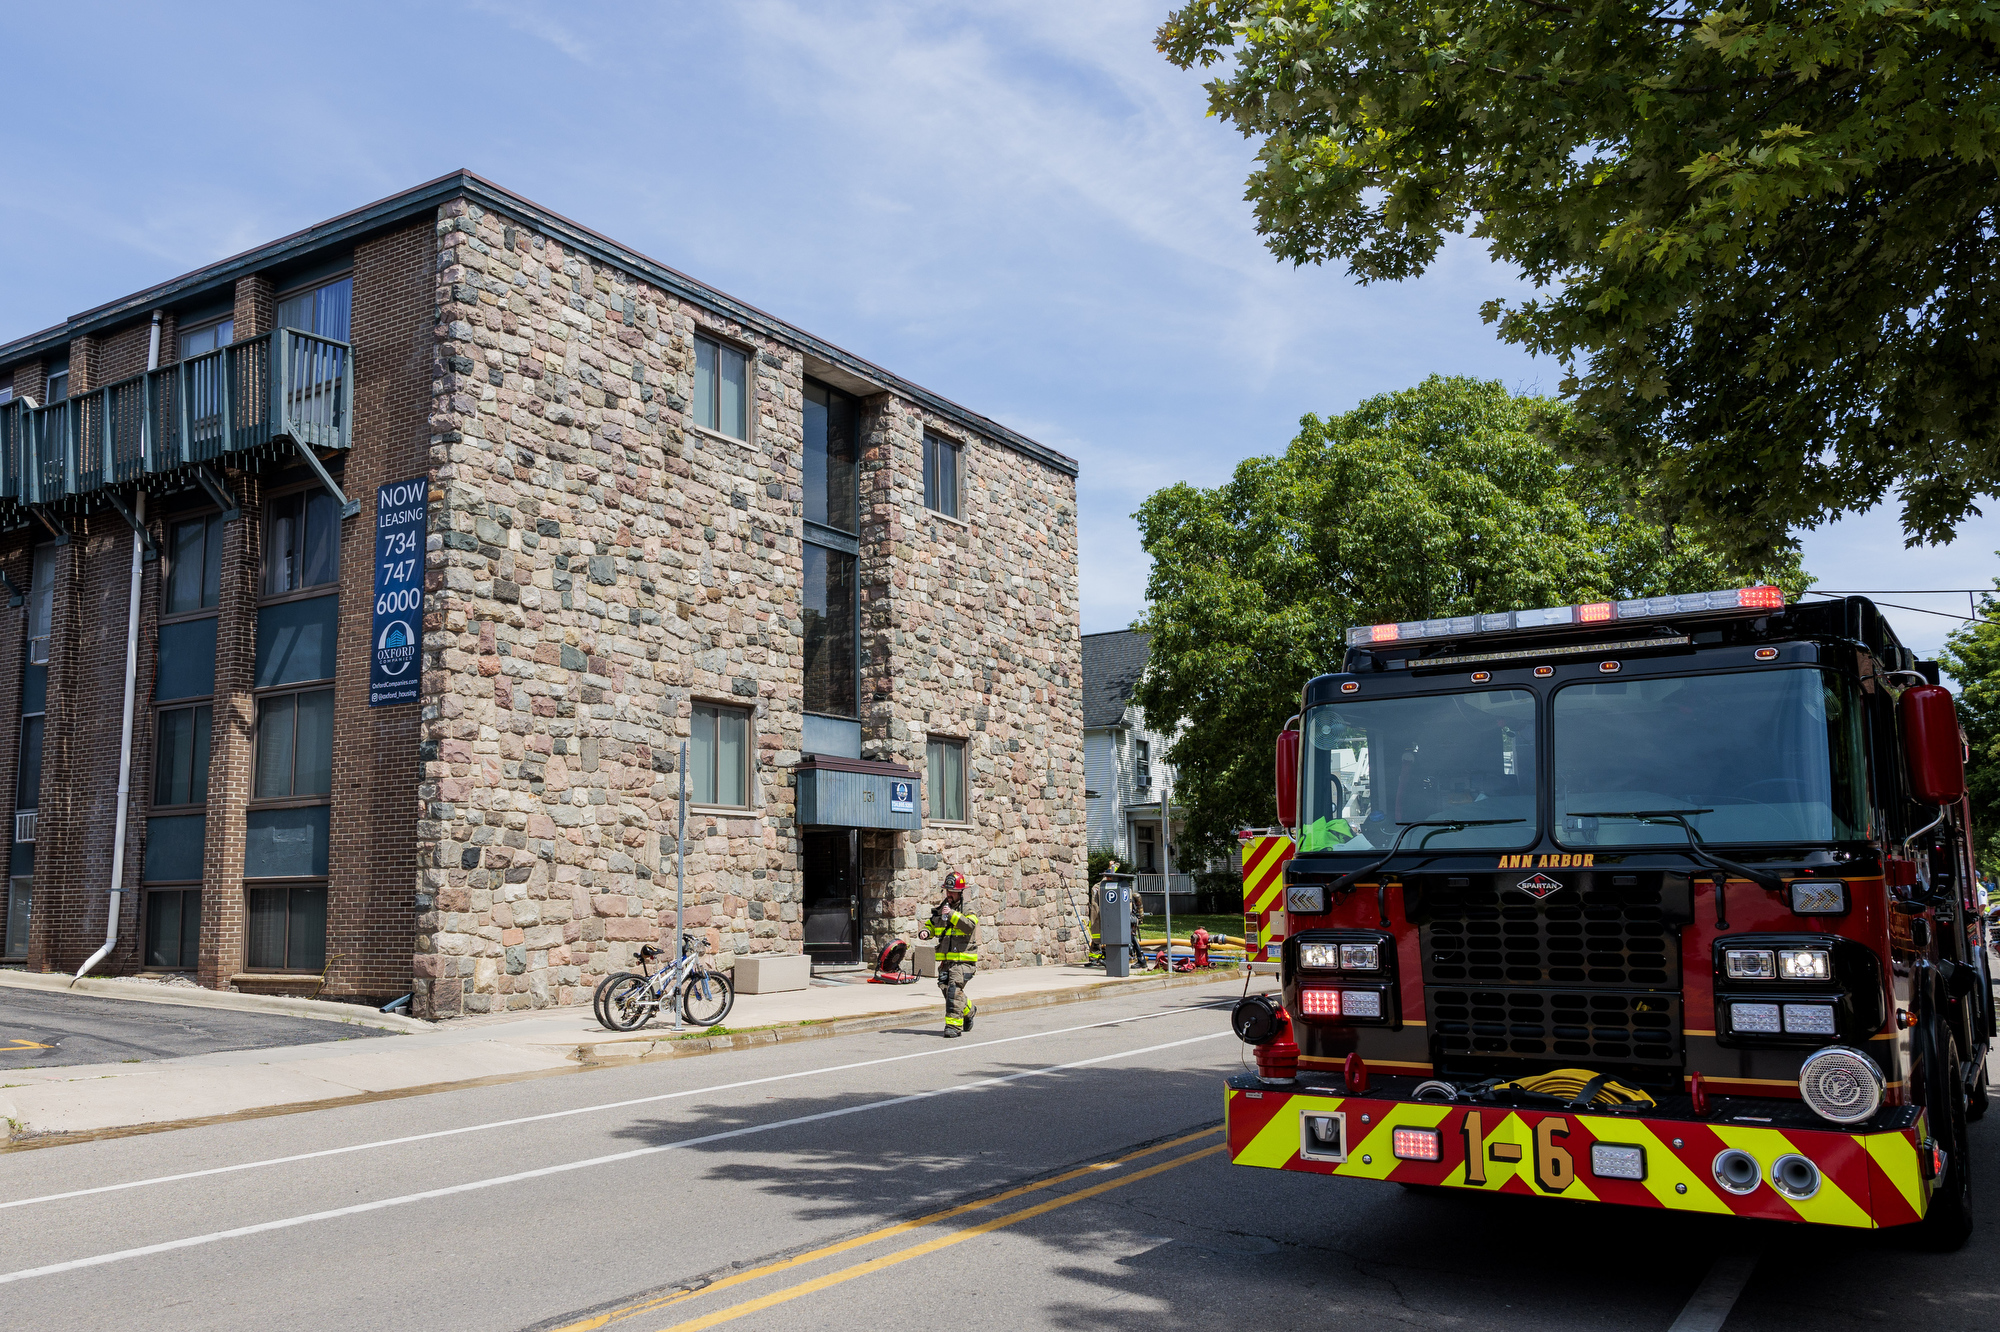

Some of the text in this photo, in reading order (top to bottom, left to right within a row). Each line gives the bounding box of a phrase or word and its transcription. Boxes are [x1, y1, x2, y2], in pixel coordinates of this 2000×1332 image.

[381, 481, 425, 509] NOW
[380, 507, 423, 528] LEASING
[384, 530, 416, 557] 734
[383, 559, 416, 586] 747
[376, 587, 421, 615] 6000
[377, 646, 415, 660] OXFORD
[379, 656, 412, 664] COMPANIES
[372, 679, 418, 689] OxfordCompanies.com
[378, 690, 417, 701] @oxford_housing
[863, 791, 874, 802] 731
[1498, 853, 1595, 869] ANN ARBOR
[1108, 892, 1115, 901] P
[1460, 1110, 1574, 1194] 1-6
